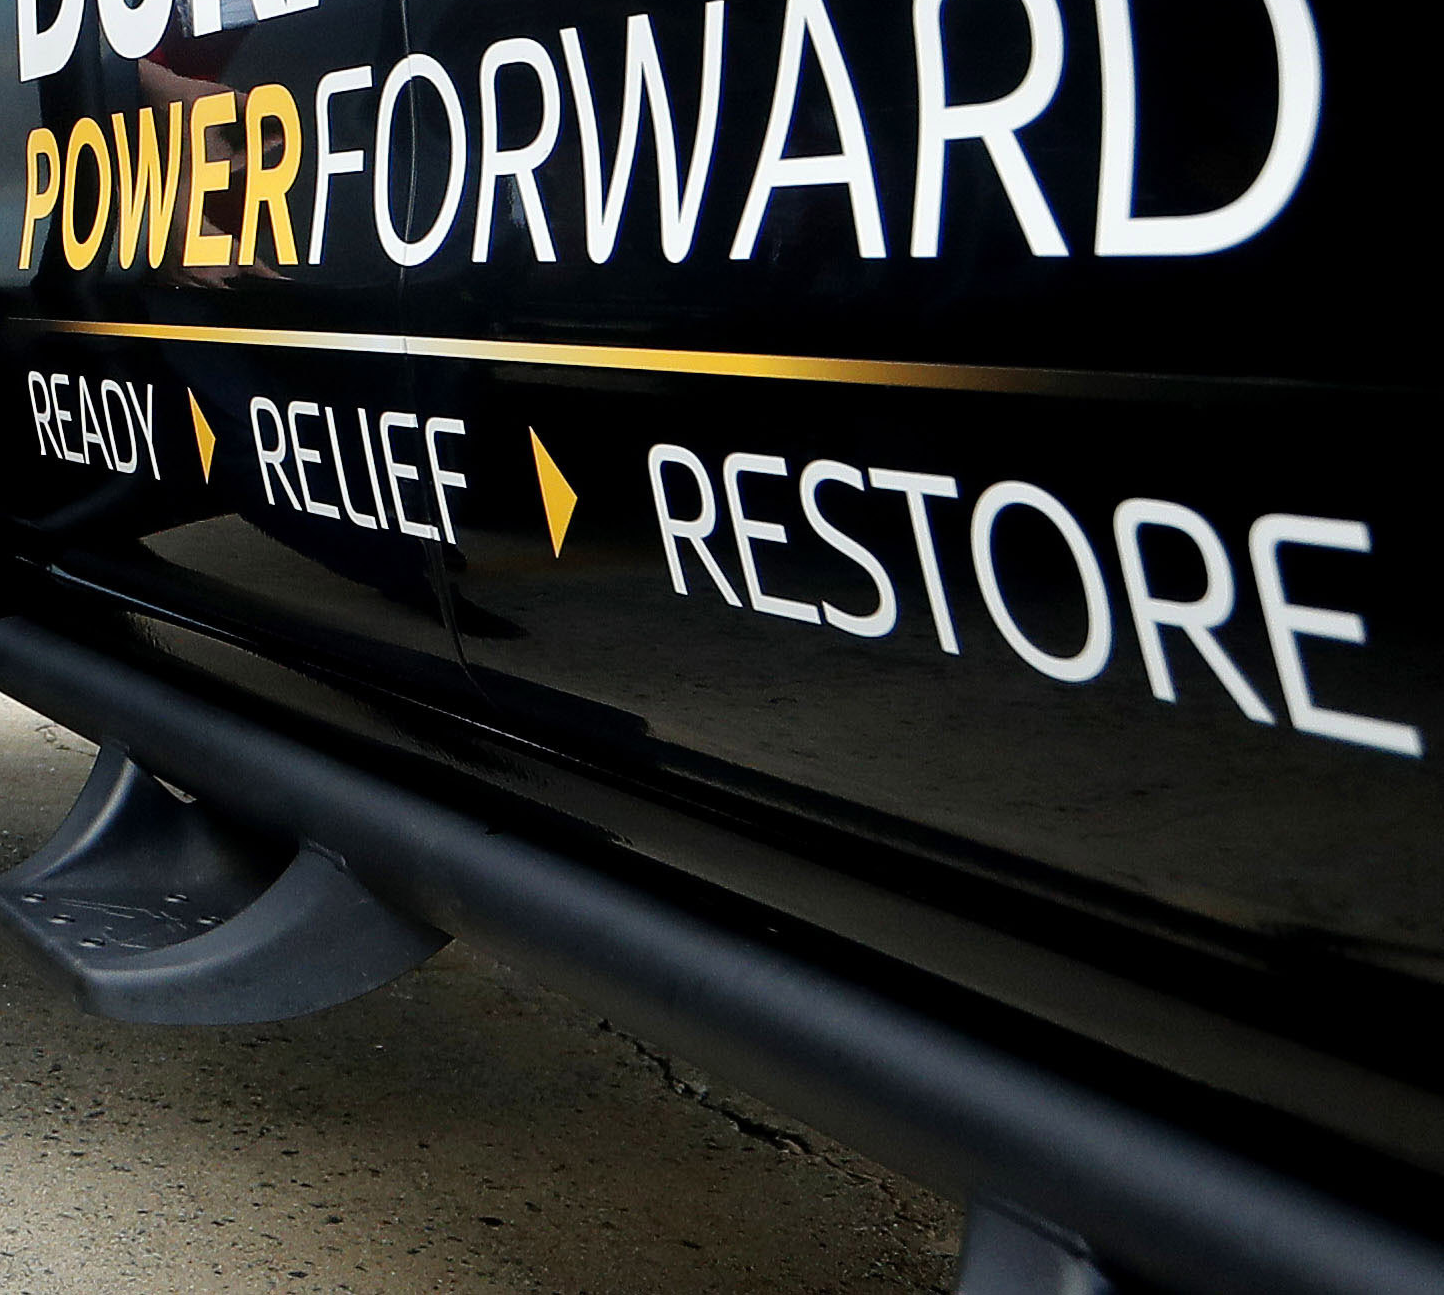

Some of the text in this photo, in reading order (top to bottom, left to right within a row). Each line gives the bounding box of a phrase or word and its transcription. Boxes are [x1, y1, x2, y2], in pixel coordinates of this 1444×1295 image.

[26, 370, 1424, 758] READY RELIEF RESTORE
